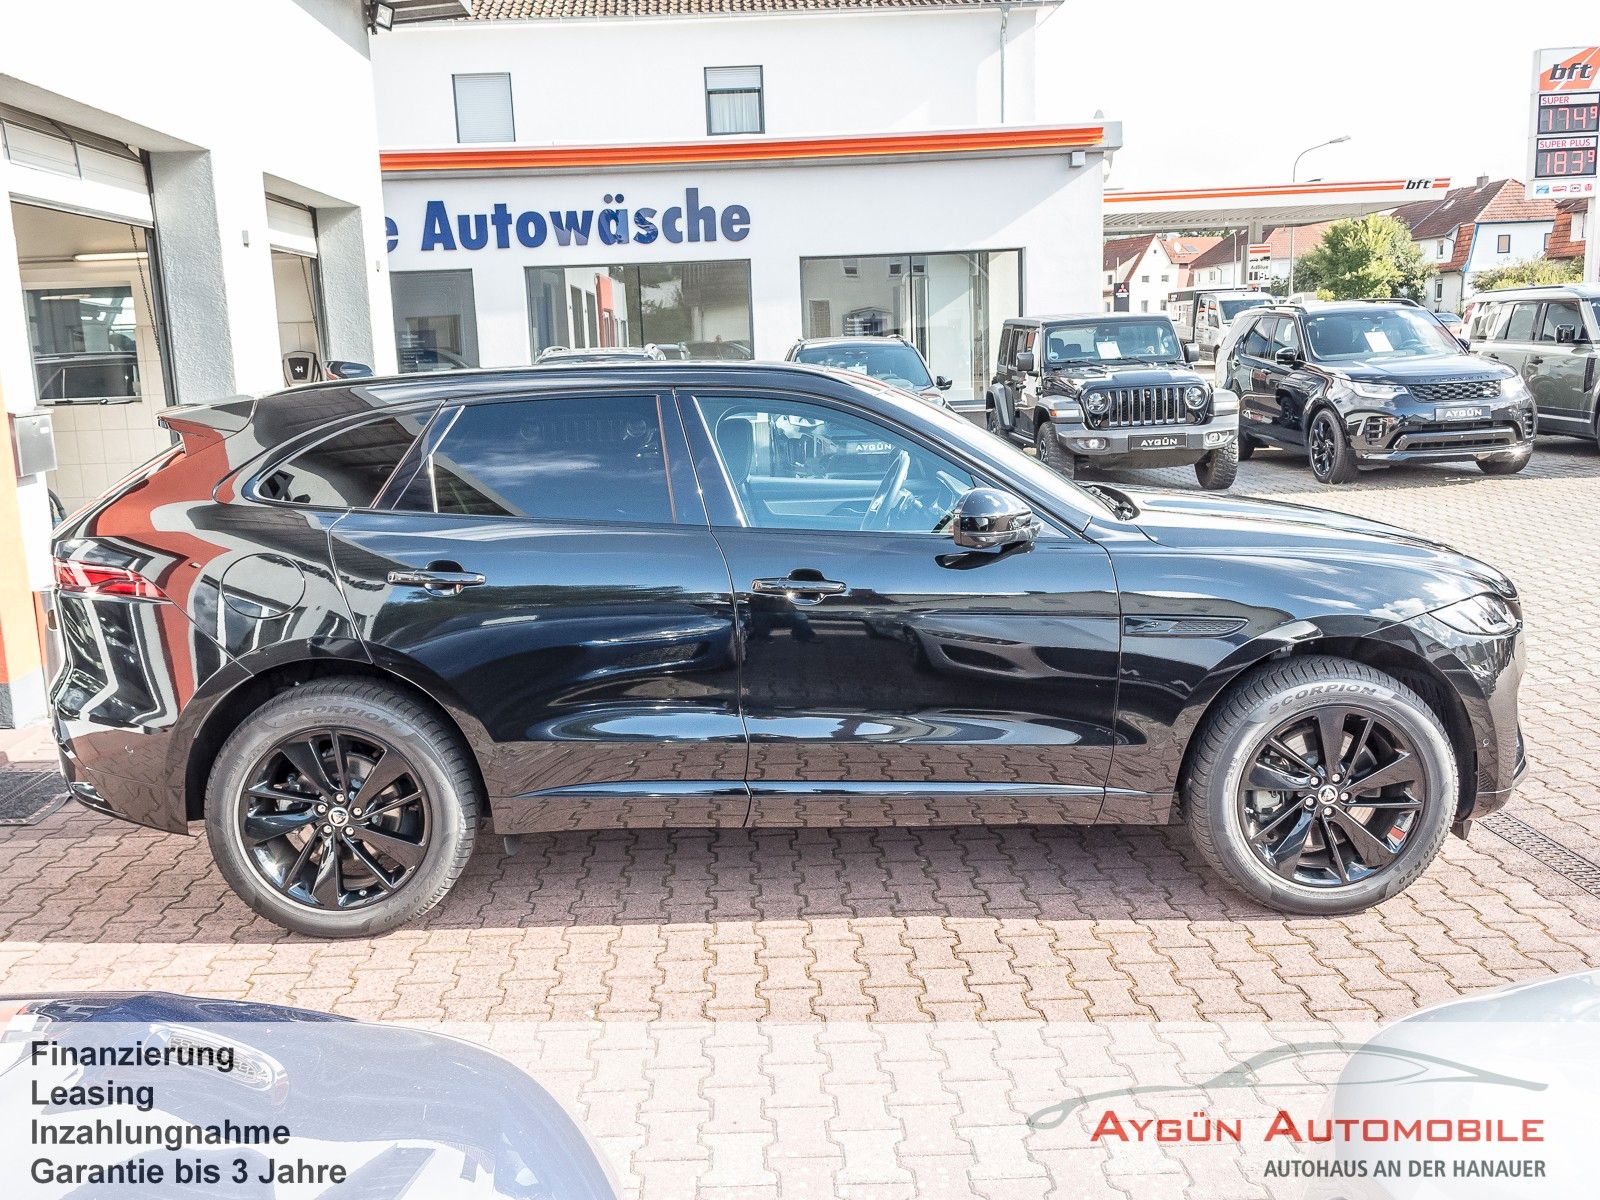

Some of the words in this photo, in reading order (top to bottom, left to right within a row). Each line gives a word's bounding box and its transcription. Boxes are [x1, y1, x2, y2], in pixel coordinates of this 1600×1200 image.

[1549, 62, 1592, 81] bft
[1542, 96, 1569, 105] SUPER
[1539, 140, 1567, 148] SUPER
[1570, 138, 1591, 147] PLUS
[1406, 179, 1431, 190] bft
[421, 187, 751, 251] Autowäsche
[1445, 408, 1482, 417] AYGÜN
[856, 441, 892, 450] AYGÜN
[1141, 437, 1177, 446] AYGÜN
[1269, 684, 1376, 715] SCORPION
